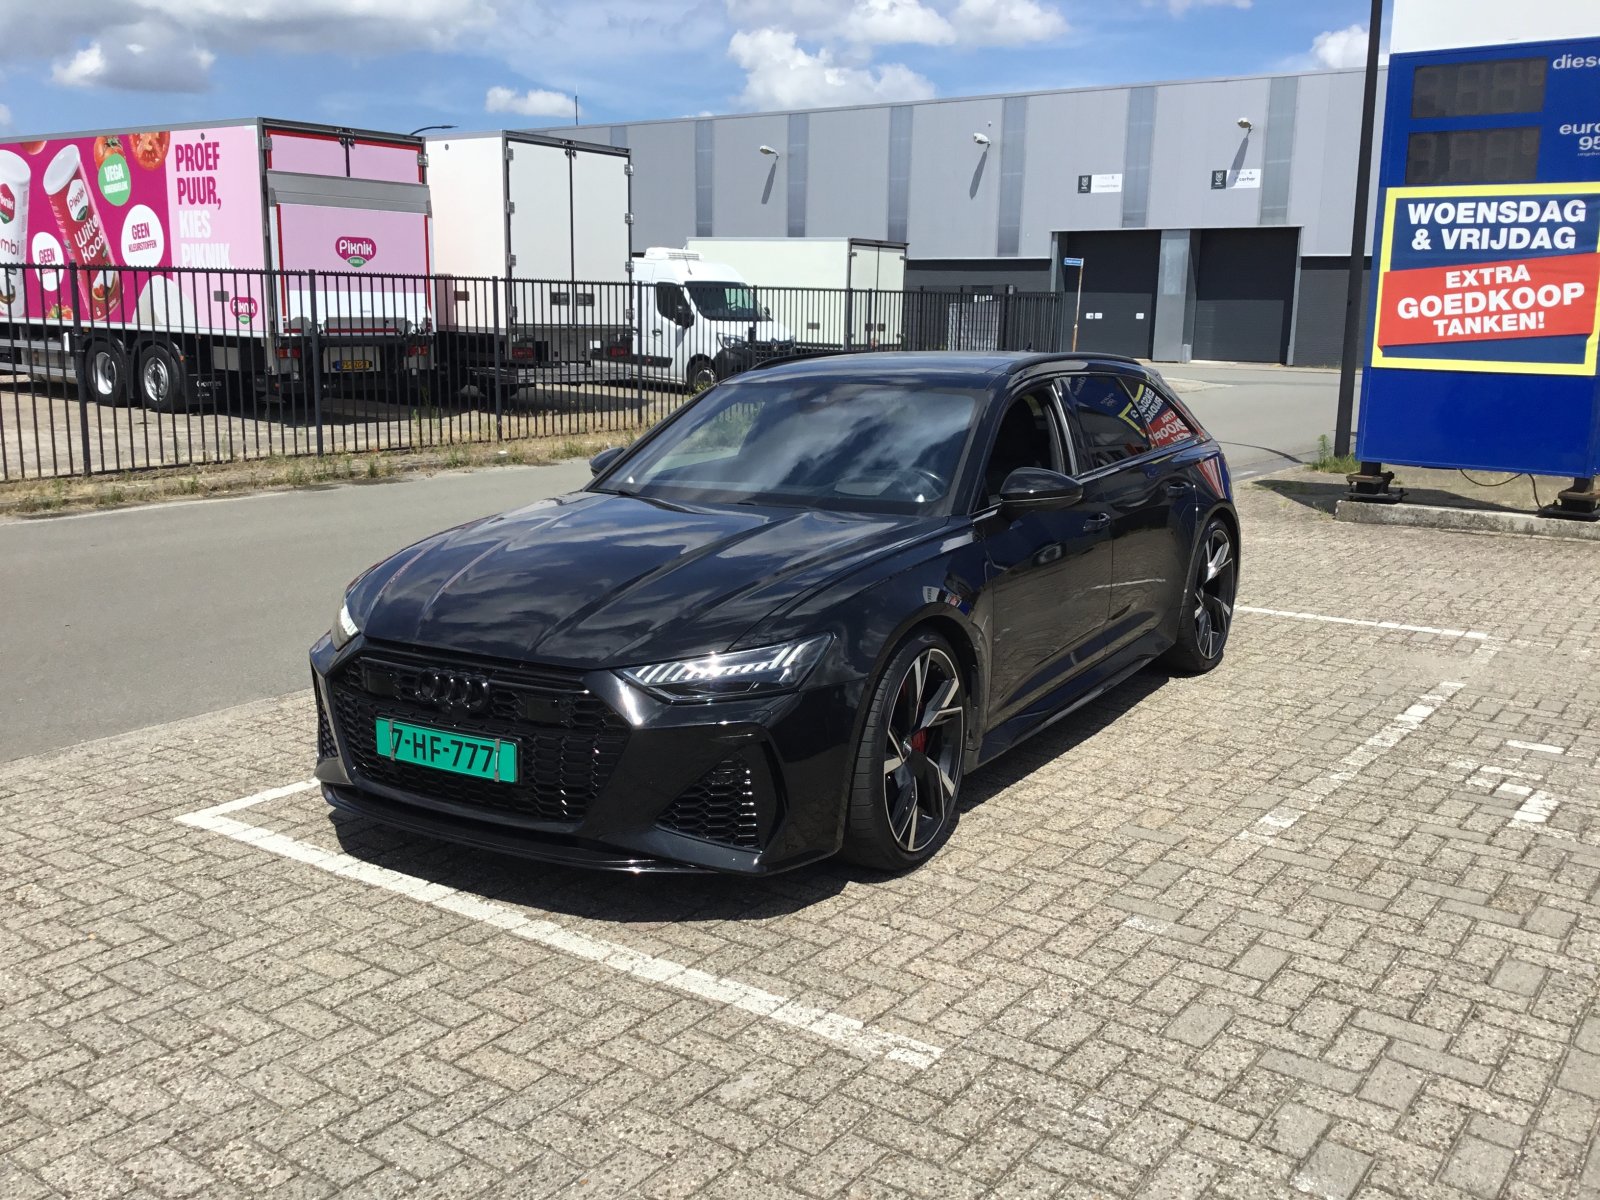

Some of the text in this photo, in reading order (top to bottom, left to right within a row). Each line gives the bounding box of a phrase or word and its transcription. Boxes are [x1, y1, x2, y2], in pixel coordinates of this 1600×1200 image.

[1552, 54, 1600, 69] dies
[175, 141, 220, 172] PROEF
[104, 163, 125, 182] VEGA
[177, 176, 222, 210] PUUR,
[178, 210, 212, 239] KIES
[1407, 200, 1586, 225] WOENSDAG
[131, 222, 151, 240] GEEN
[1411, 226, 1576, 250] & VRIJDAG
[339, 239, 373, 256] Piknik
[1445, 264, 1531, 289] EXTRA
[1397, 282, 1585, 319] GOEDKOOP
[1433, 311, 1546, 337] TANKEN!
[391, 727, 495, 773] 7-HF-777
